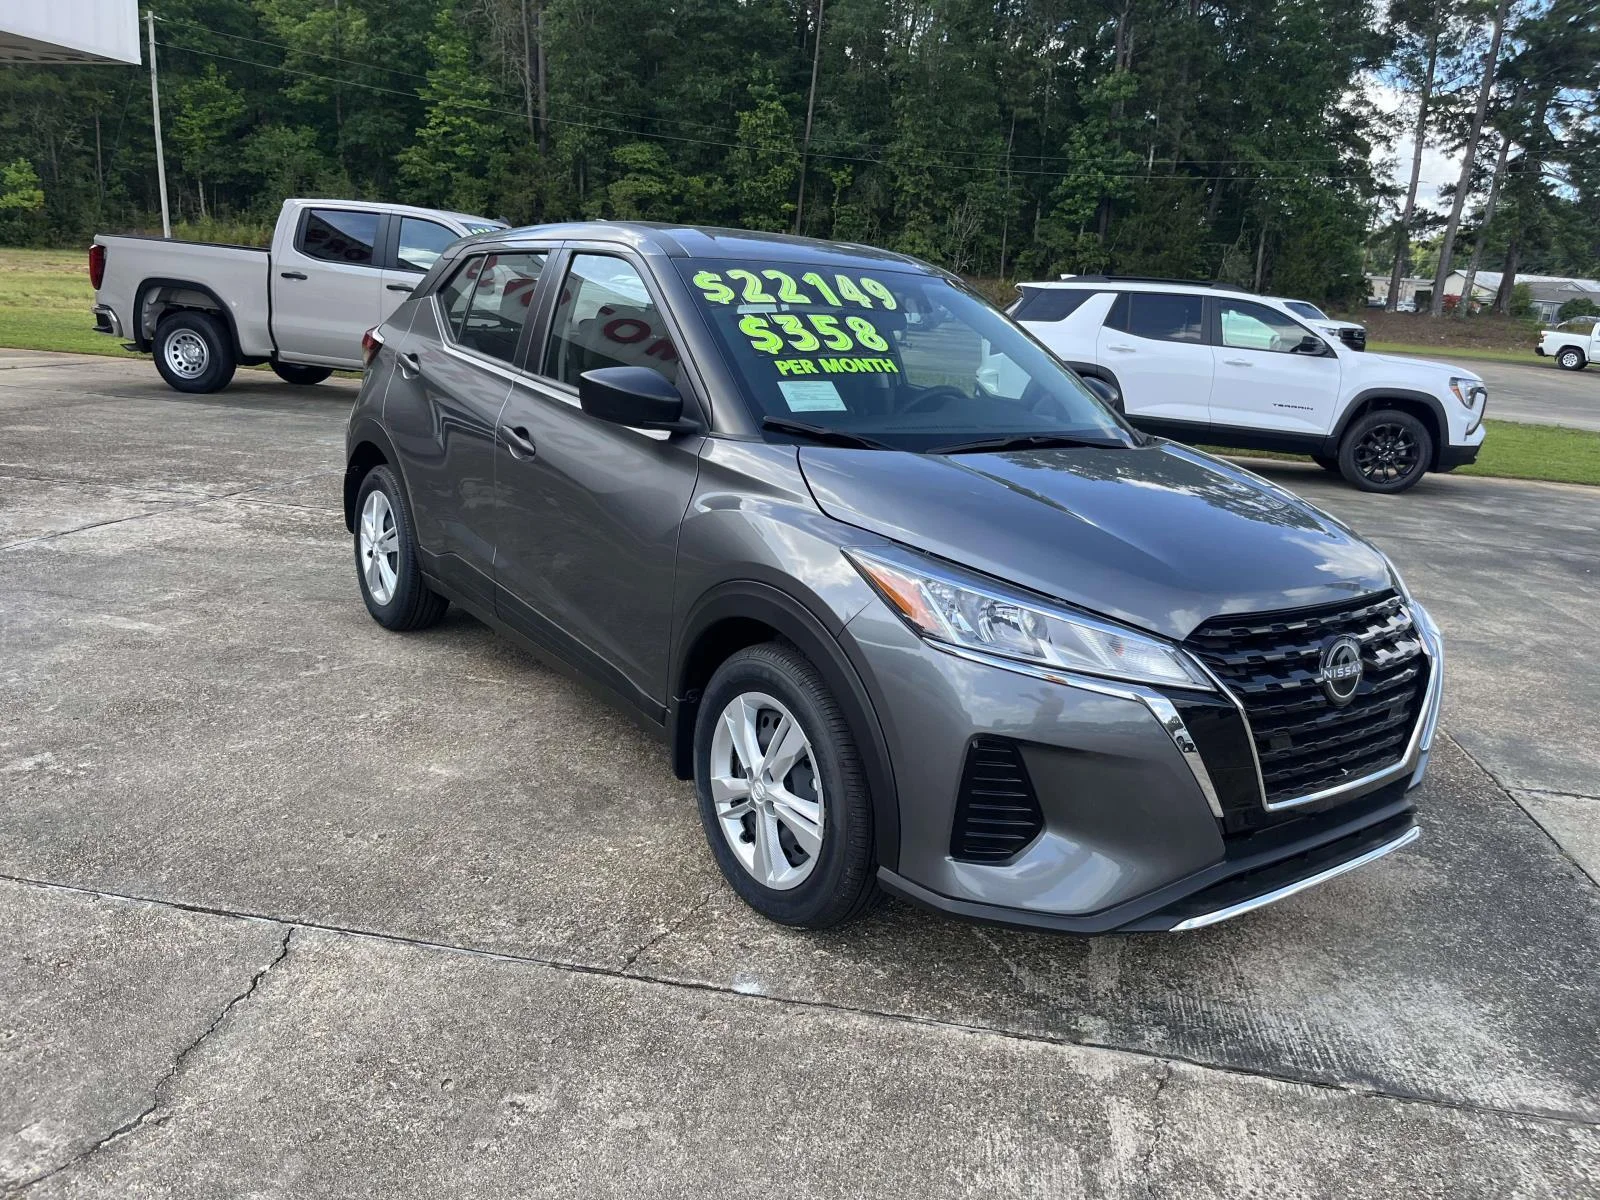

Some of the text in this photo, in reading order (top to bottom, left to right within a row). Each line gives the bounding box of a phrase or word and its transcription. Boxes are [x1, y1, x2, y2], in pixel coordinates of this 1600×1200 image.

[692, 269, 898, 310] $22149
[738, 314, 889, 355] $358
[774, 358, 899, 376] PER MONTH
[1272, 402, 1314, 411] TERRAIN
[1323, 663, 1362, 679] NISSAN
